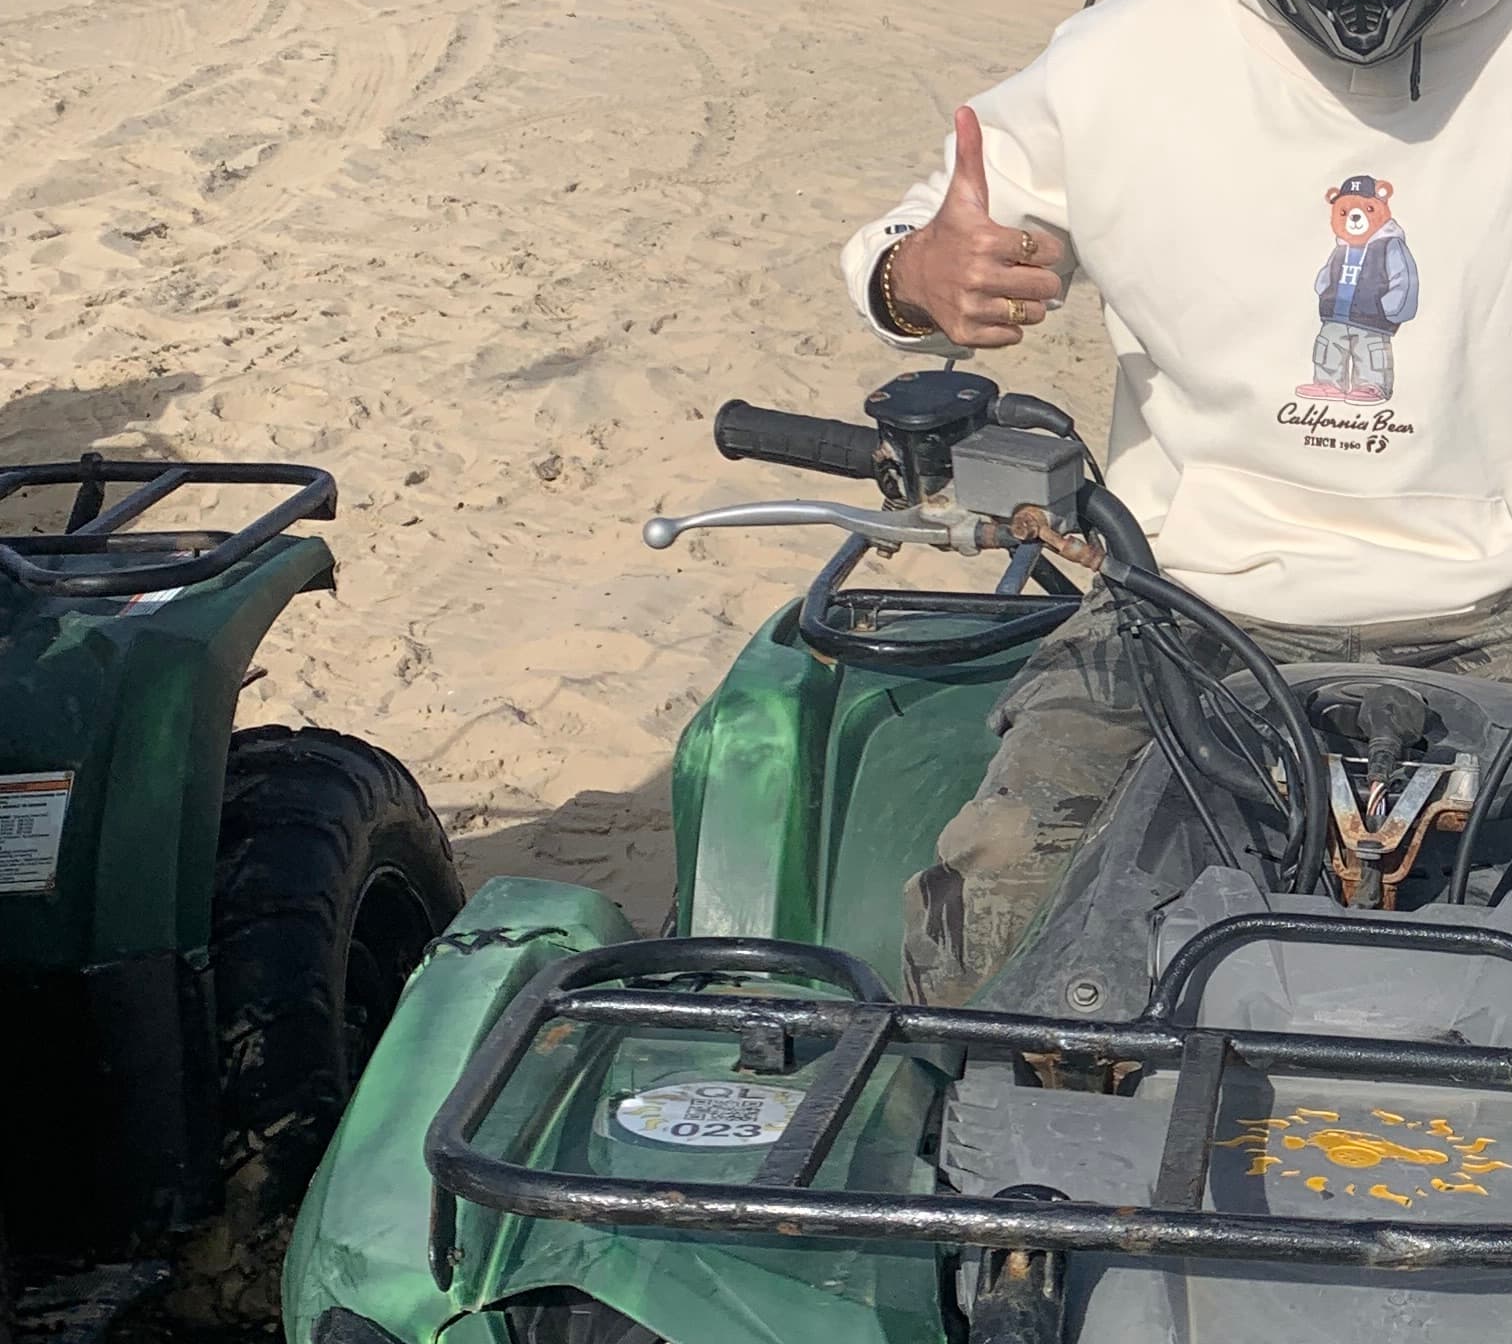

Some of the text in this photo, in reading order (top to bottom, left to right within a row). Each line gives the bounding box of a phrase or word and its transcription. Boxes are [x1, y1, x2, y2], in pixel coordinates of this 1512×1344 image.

[1339, 264, 1362, 286] H
[1277, 402, 1415, 434] California Bear
[1303, 436, 1337, 449] SINCE
[695, 1086, 765, 1100] QL
[670, 1122, 762, 1138] 023
